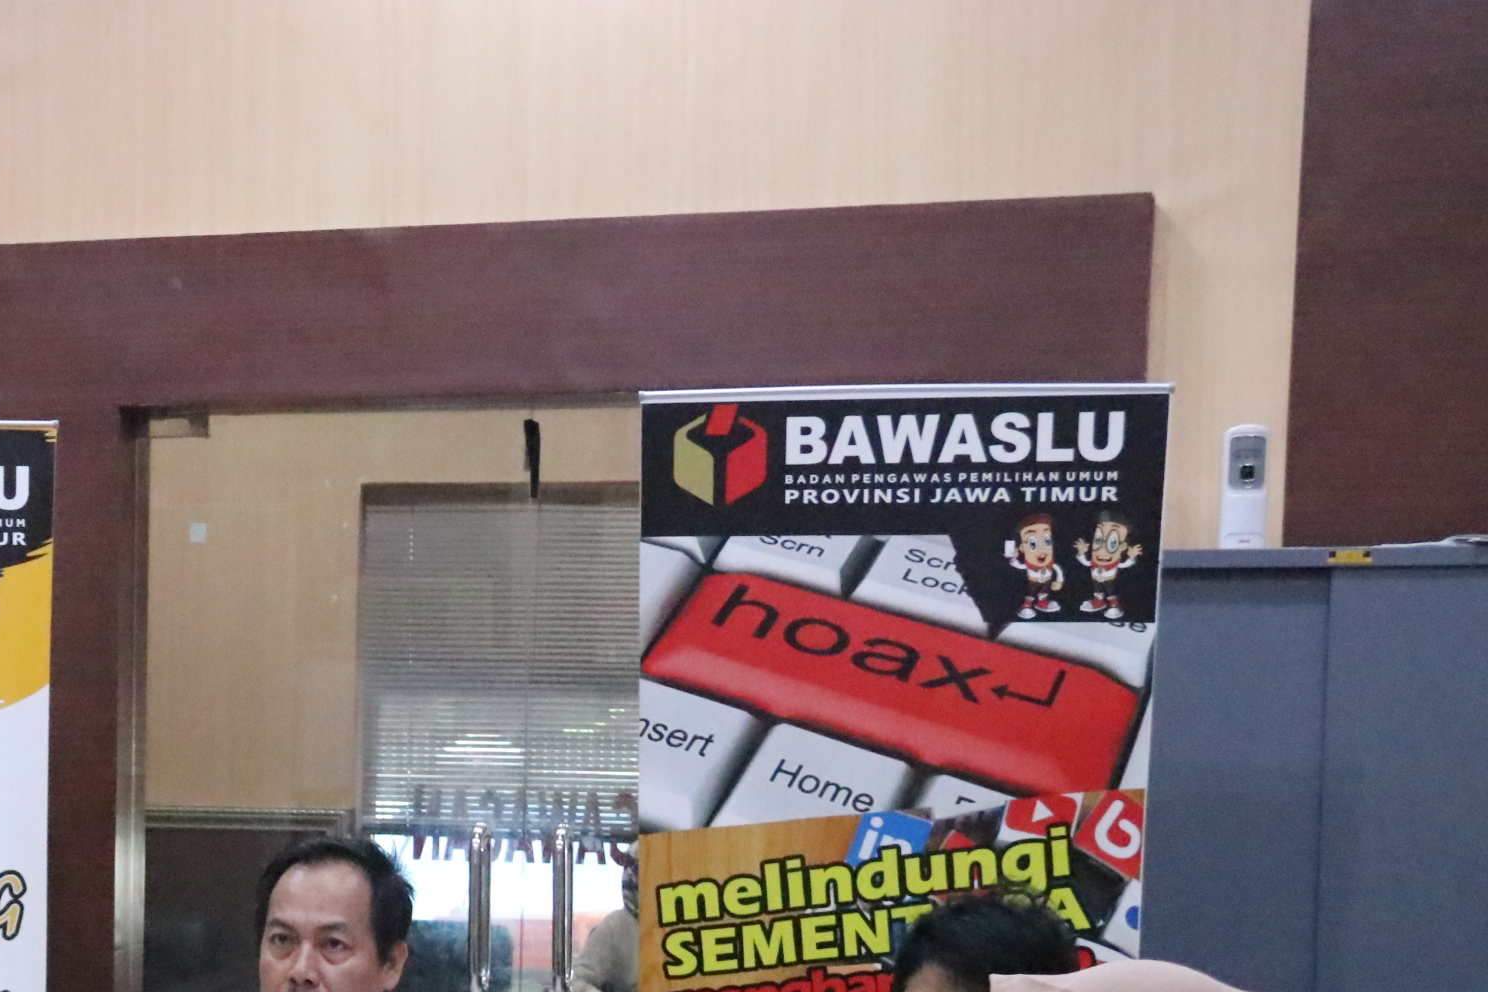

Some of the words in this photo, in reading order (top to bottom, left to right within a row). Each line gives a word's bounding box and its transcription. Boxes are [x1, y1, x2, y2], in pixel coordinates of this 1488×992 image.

[784, 410, 1126, 466] BAWASLU
[784, 474, 846, 485] BADAN
[852, 472, 952, 484] PENGAWAS
[958, 471, 1060, 483] PEMILIHAN
[1066, 470, 1119, 482] UMUM
[784, 488, 921, 504] PROVINSI
[929, 486, 1012, 504] JAWA
[1020, 485, 1119, 503] TIMUR
[712, 582, 992, 705] hoax
[768, 757, 876, 813] Home
[657, 824, 1072, 926] melindungi
